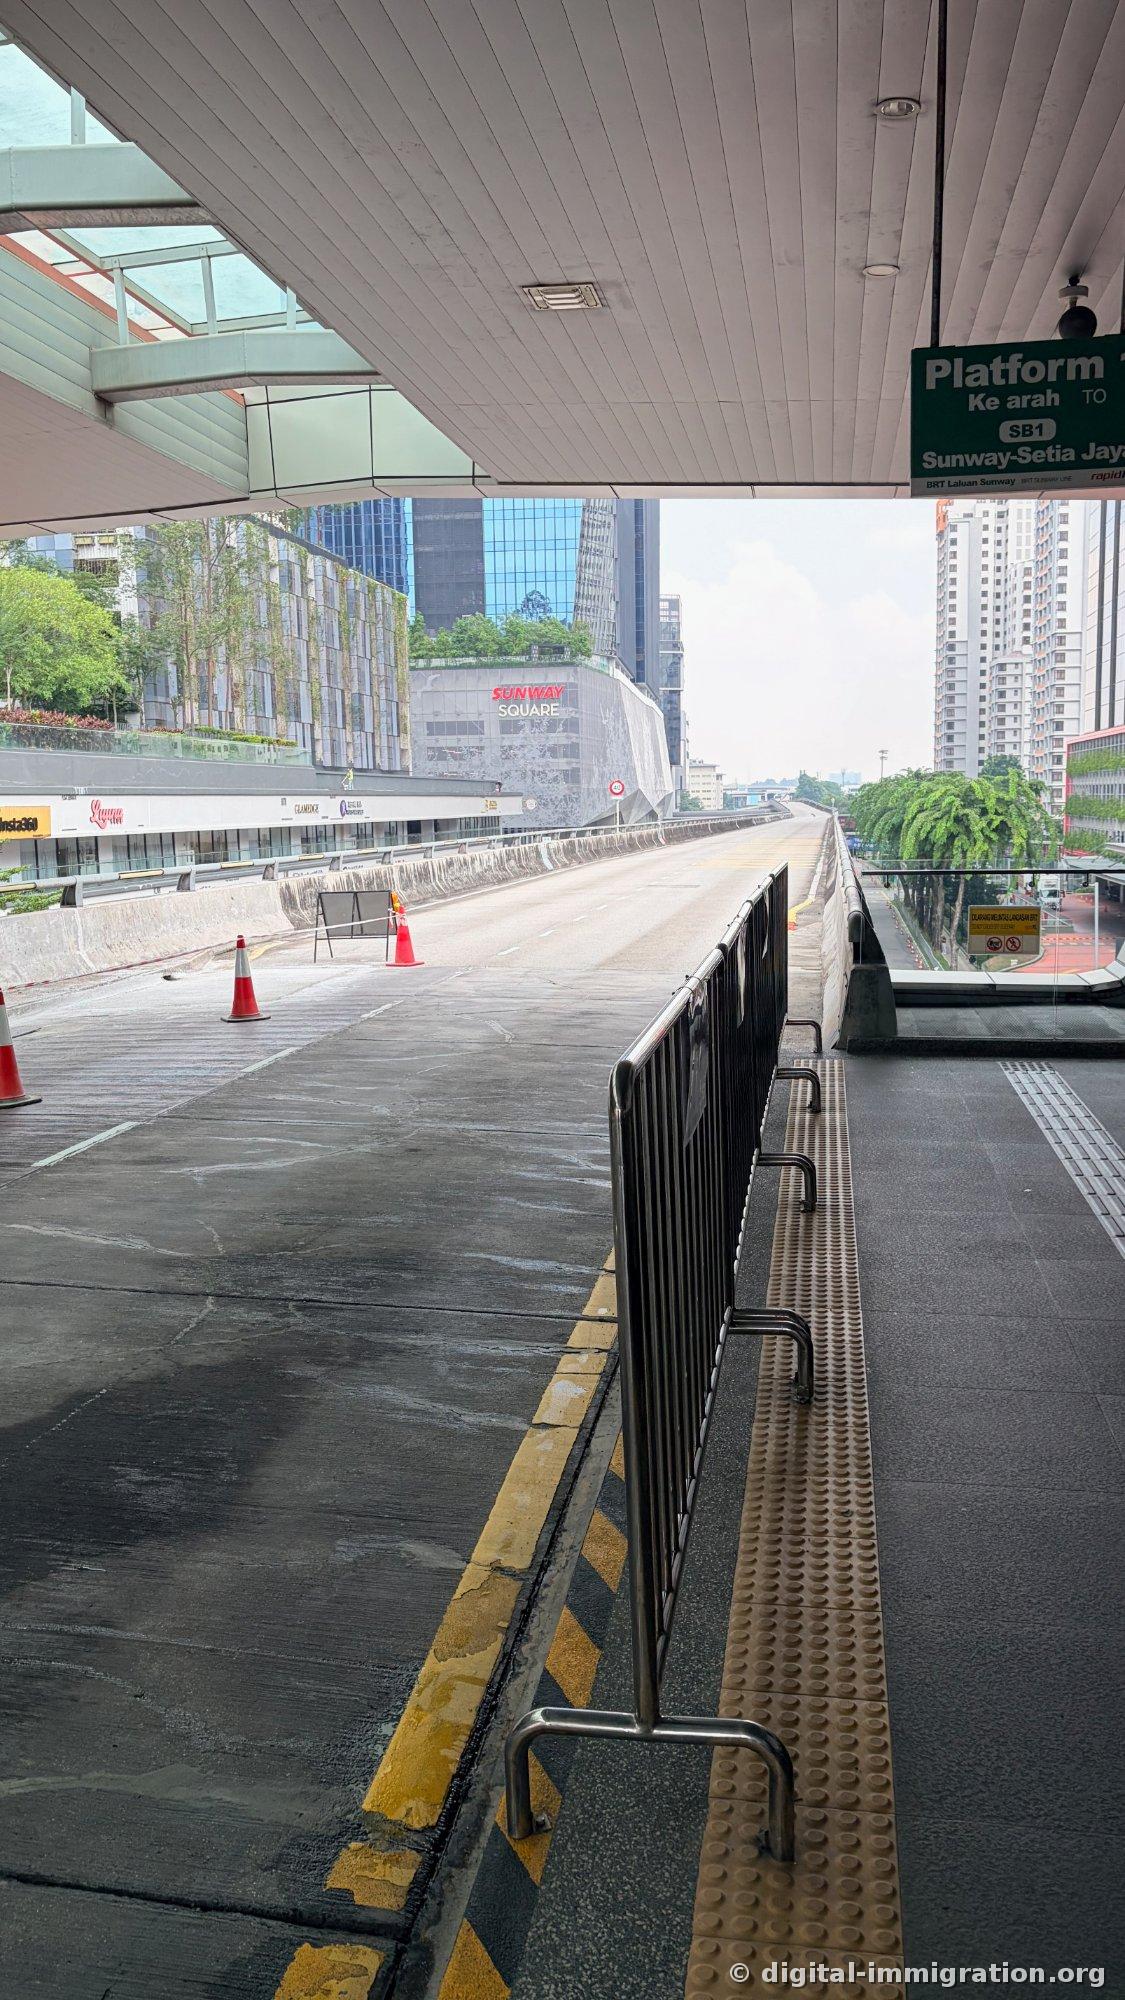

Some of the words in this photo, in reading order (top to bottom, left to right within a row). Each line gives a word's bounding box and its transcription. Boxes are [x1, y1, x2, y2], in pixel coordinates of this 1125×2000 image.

[926, 353, 1104, 390] Platform
[968, 393, 1000, 411] Ke
[1006, 389, 1060, 409] arah
[1082, 388, 1107, 404] TO
[1009, 423, 1044, 438] SB1
[922, 444, 1075, 469] Sunway-Setia
[926, 480, 945, 488] BRT
[947, 479, 978, 488] Laluan
[980, 477, 1016, 487] Sunway
[492, 685, 564, 700] SUNWAY
[498, 702, 560, 718] SQUARE
